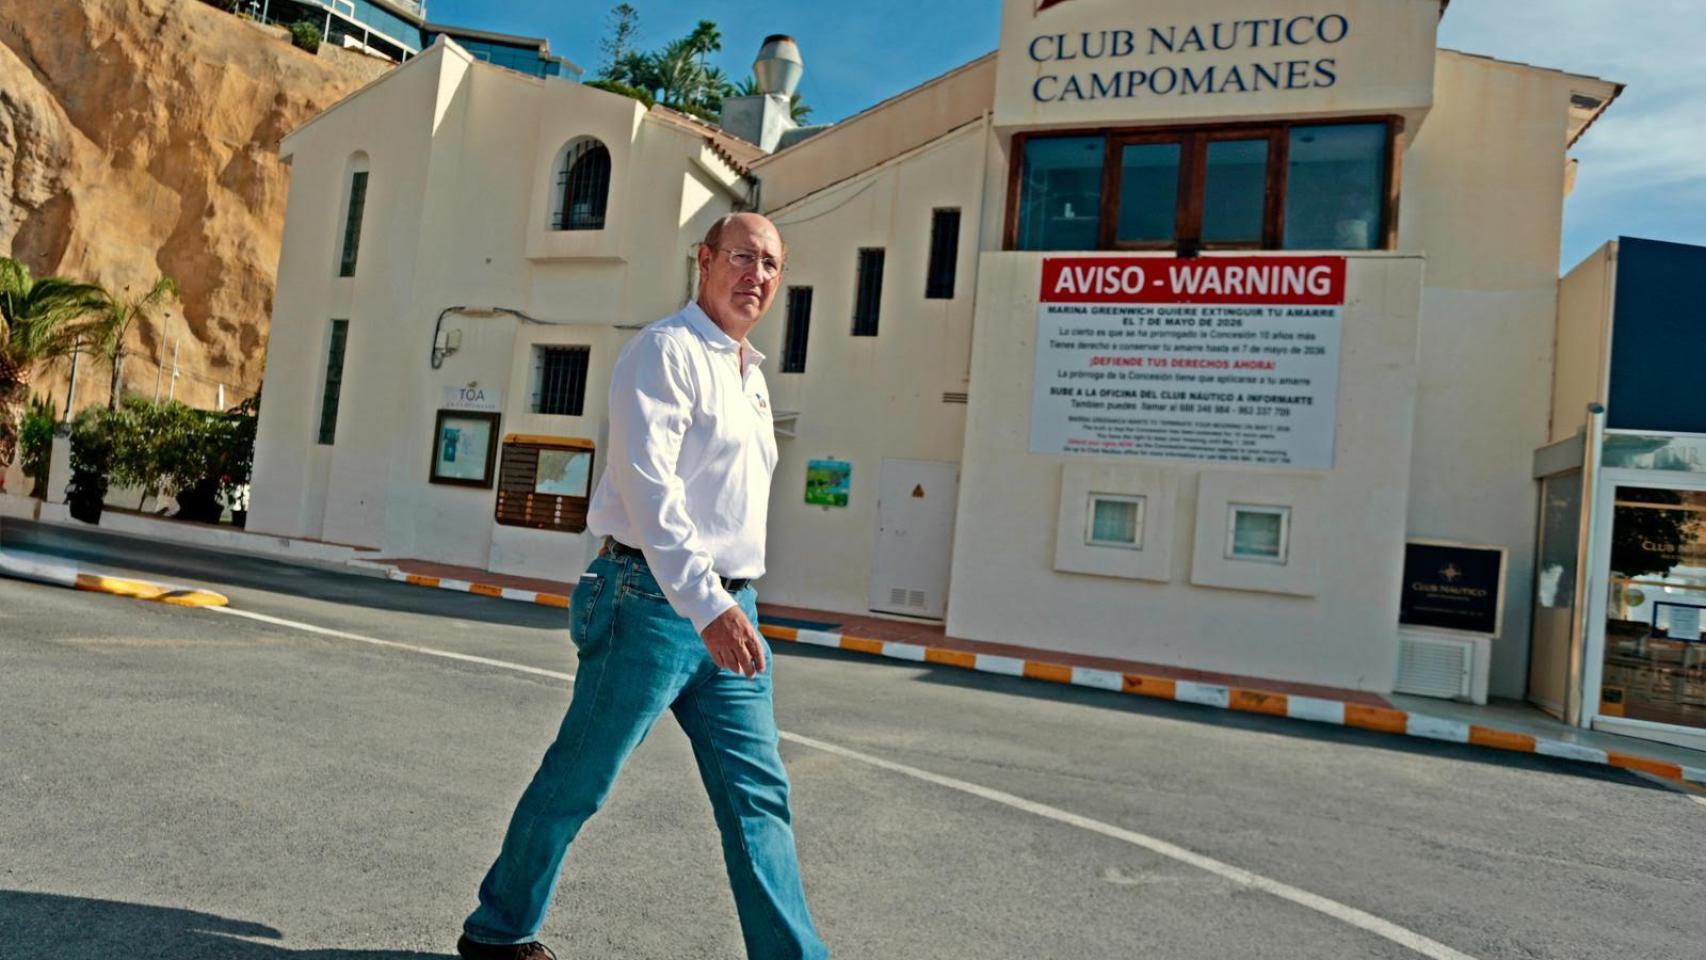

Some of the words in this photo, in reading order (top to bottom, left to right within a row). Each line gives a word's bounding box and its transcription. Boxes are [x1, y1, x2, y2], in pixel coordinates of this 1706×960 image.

[1029, 29, 1135, 62] CLUB
[1147, 14, 1349, 56] NAUTICO
[1033, 58, 1336, 102] CAMPOMANES
[1054, 265, 1145, 295] AVISO
[1168, 265, 1332, 296] WARNING
[1048, 306, 1088, 314] MARINA
[1091, 306, 1154, 315] GREENWICH
[1157, 308, 1197, 316] QUIERE
[1202, 308, 1263, 317] EXTINGUIR
[1268, 308, 1283, 317] TU
[1286, 309, 1335, 317] AMARRE
[1123, 318, 1134, 326] EL
[1148, 318, 1160, 326] DE
[1165, 318, 1196, 326] MAYO
[1200, 319, 1212, 327] DE
[1108, 330, 1123, 338] que
[1138, 329, 1148, 337] ha
[1150, 329, 1197, 339] prorrogado
[1272, 331, 1294, 340] años
[1050, 340, 1075, 349] Tienes
[1077, 341, 1110, 350] derecho
[1206, 344, 1229, 352] hasta
[1250, 345, 1260, 353] de
[1263, 346, 1288, 356] mayo
[1291, 346, 1302, 354] de
[1147, 358, 1167, 367] TUS
[1171, 358, 1229, 369] DERECHOS
[1233, 360, 1276, 370] AHORA!
[1057, 370, 1067, 378] La
[1107, 371, 1117, 379] de
[1175, 372, 1196, 381] tiene
[1199, 375, 1214, 384] que
[1217, 374, 1257, 385] aplicarse
[1279, 378, 1311, 386] amarre
[460, 389, 484, 401] TOA
[1050, 387, 1074, 396] SUBE
[1076, 388, 1082, 396] A
[1085, 388, 1097, 397] LA
[1099, 389, 1137, 398] OFICINA
[1140, 390, 1157, 399] DEL
[1160, 391, 1186, 400] CLUB
[1236, 394, 1244, 402] A
[1247, 394, 1313, 405] INFORMARTE
[1107, 402, 1137, 411] puedes
